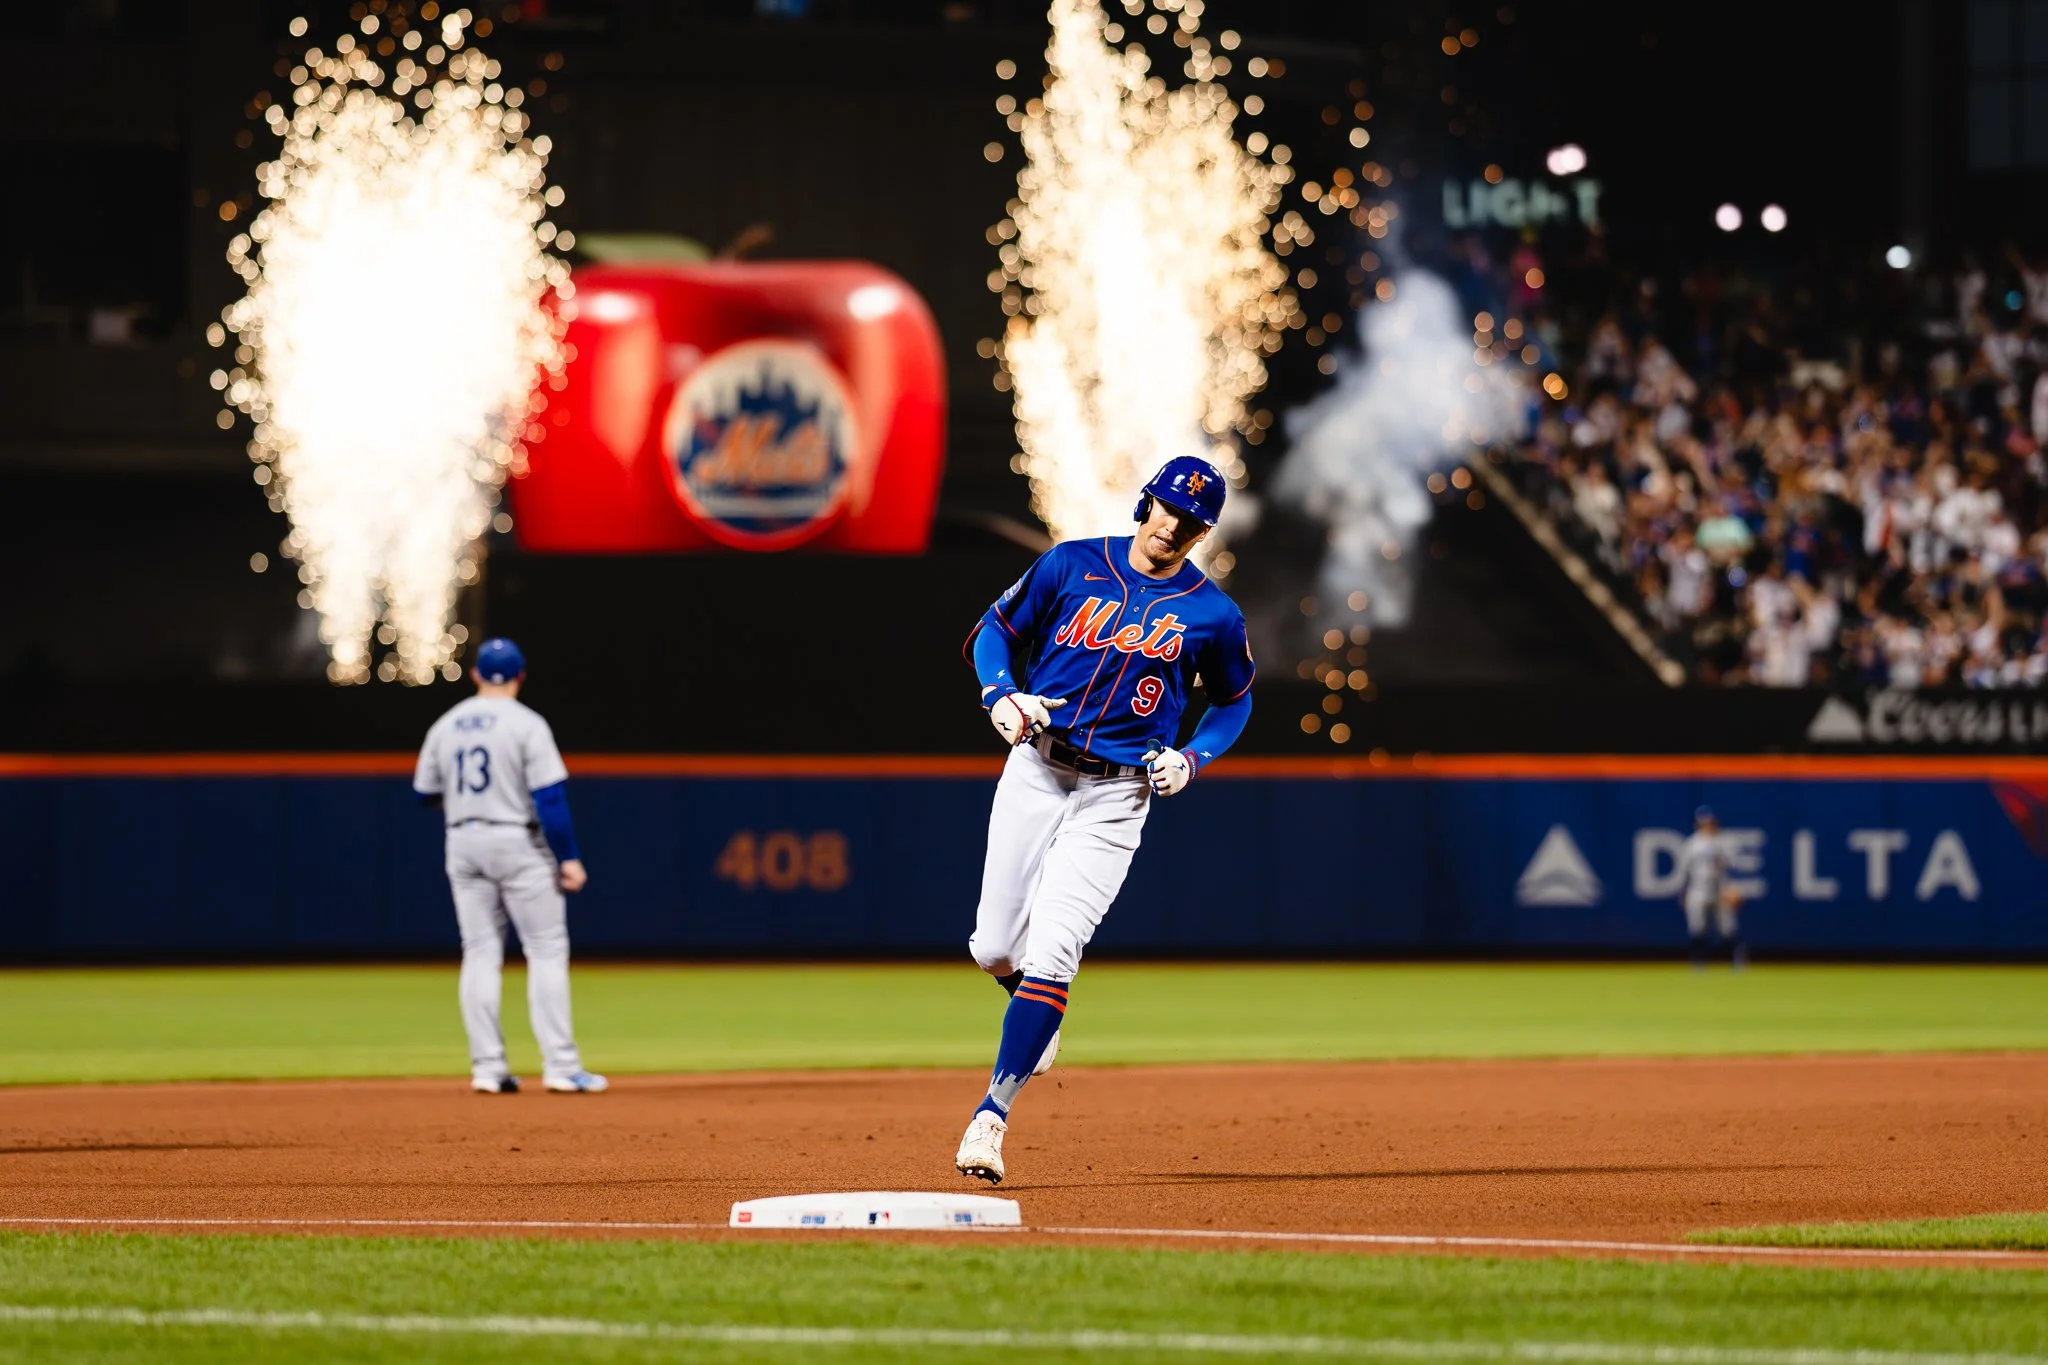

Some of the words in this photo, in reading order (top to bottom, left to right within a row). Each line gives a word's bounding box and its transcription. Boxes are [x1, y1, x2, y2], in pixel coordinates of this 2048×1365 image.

[1055, 596, 1187, 662] Mets
[1131, 676, 1164, 716] 9
[456, 745, 491, 796] 13
[712, 828, 848, 891] 408
[1633, 828, 1981, 901] DELTA
